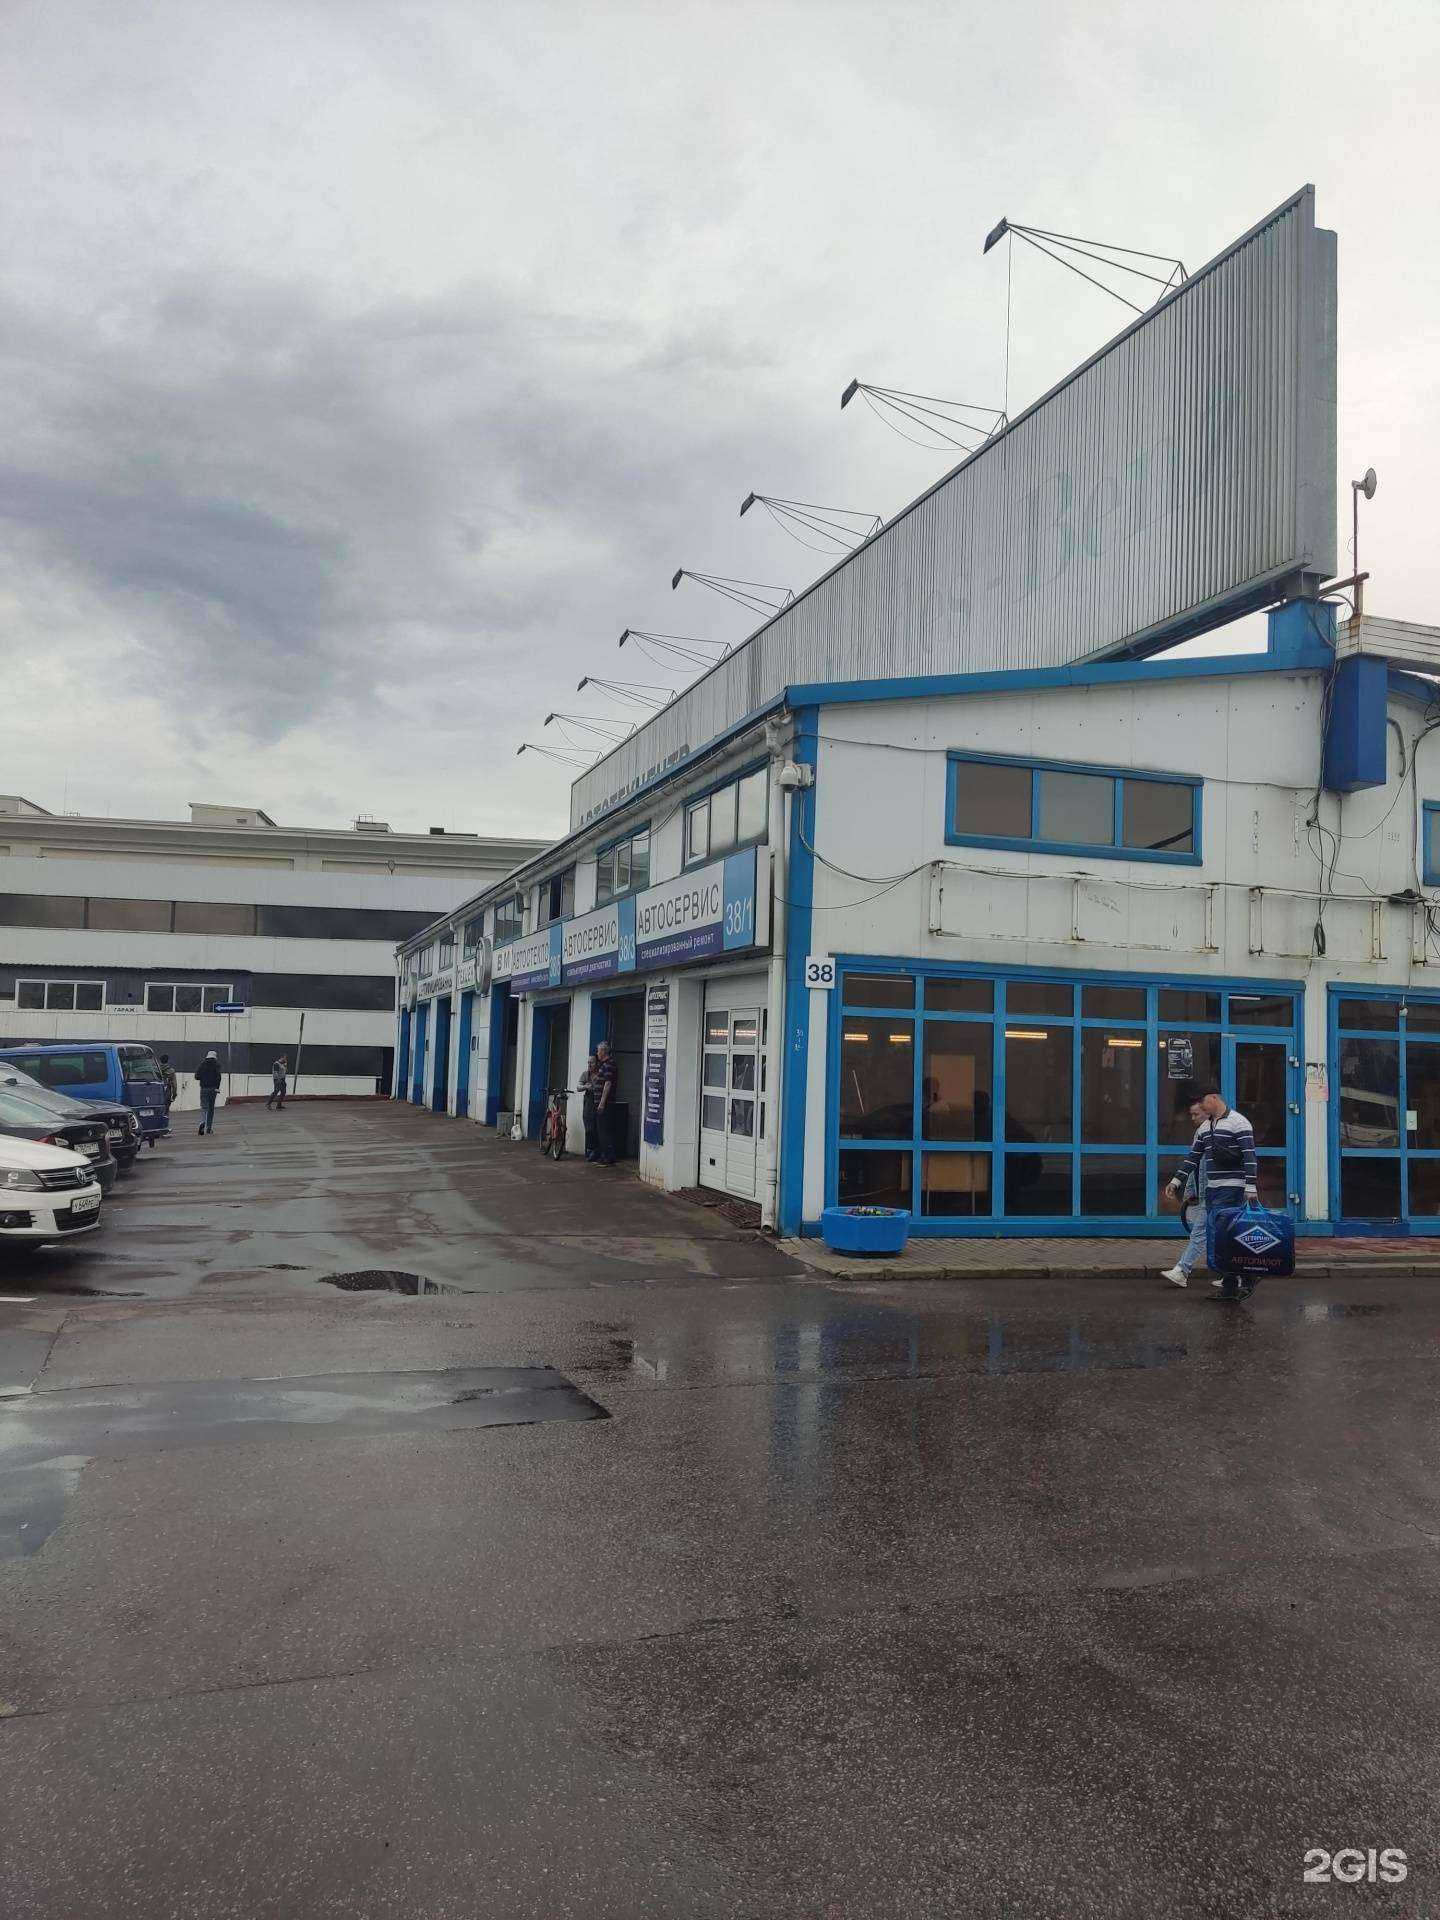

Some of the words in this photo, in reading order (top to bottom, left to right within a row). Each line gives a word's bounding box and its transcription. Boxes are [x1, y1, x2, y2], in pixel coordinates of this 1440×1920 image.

[637, 883, 719, 936] АВТОСЕРВИС
[726, 896, 752, 935] 38/1
[563, 920, 617, 958] АВТОСЕРВИС
[693, 933, 715, 951] ремонт
[808, 963, 833, 983] 38
